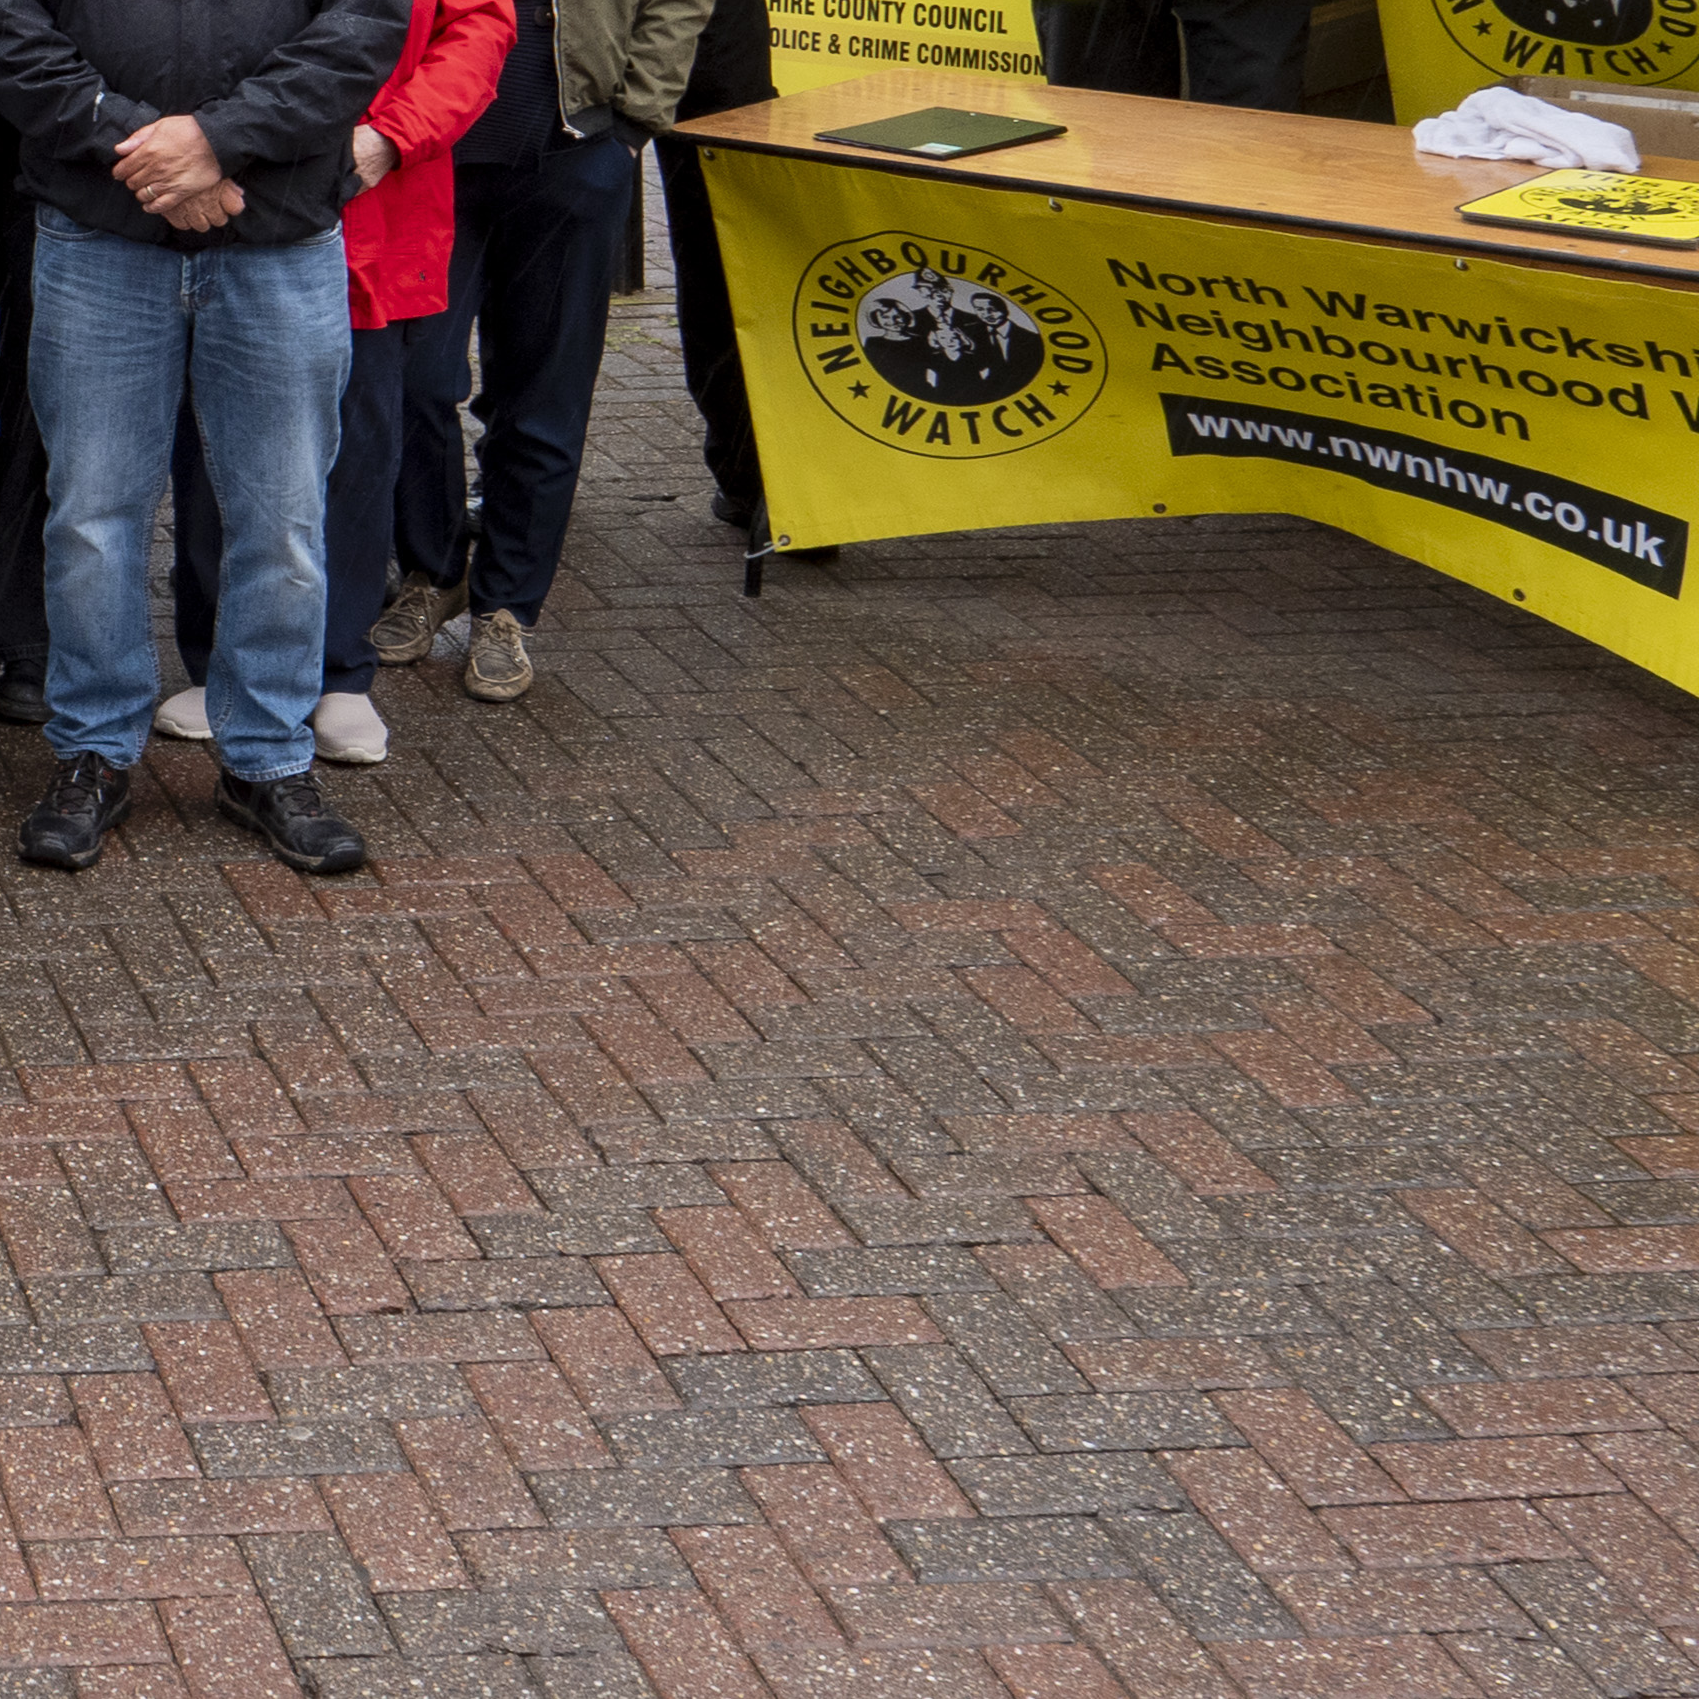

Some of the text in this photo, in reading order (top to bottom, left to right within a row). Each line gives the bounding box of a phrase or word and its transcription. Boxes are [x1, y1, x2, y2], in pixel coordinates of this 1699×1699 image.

[913, 2, 1008, 35] COUNCIL
[770, 27, 1046, 77] OLICE & CRIME COMMISSION
[1503, 30, 1660, 77] WATCH
[810, 240, 1094, 375] NEIGHBOURHOOD
[1105, 257, 1290, 309] North
[1125, 298, 1651, 421] Neighbourhood
[881, 392, 1057, 446] WATCH
[1151, 342, 1531, 442] Association
[1186, 412, 1665, 567] www.nwnhw.co.uk
